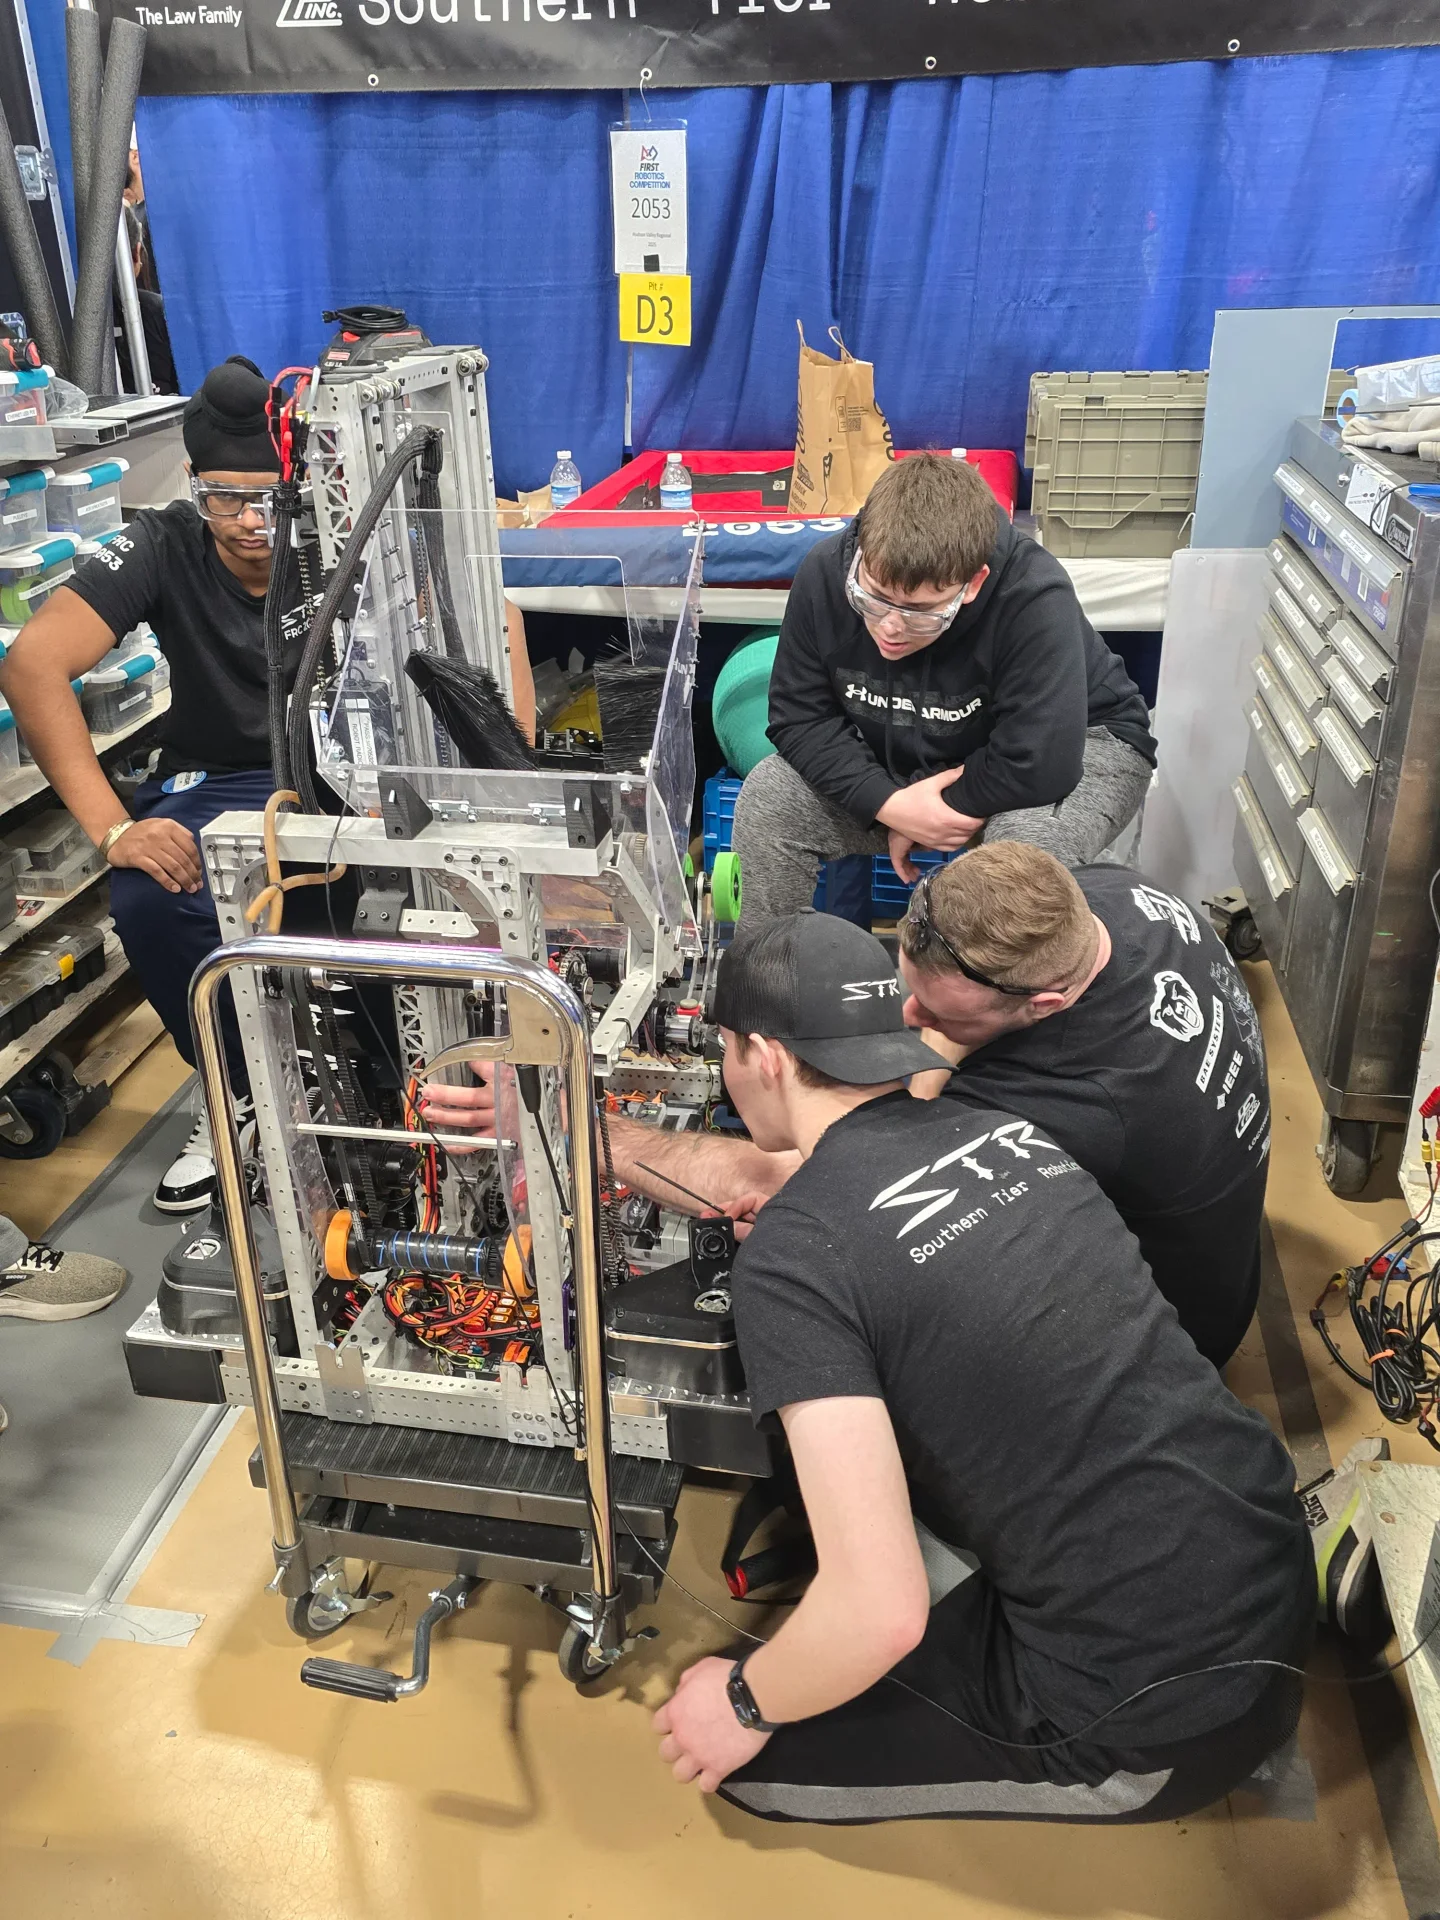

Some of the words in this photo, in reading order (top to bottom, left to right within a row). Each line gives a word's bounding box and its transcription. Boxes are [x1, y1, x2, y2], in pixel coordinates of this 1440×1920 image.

[135, 7, 163, 25] The
[165, 6, 197, 25] Law
[198, 5, 243, 28] Family
[634, 172, 665, 181] ROBOTICS
[639, 162, 660, 172] FIRST
[629, 180, 671, 189] COMPETITION
[631, 197, 671, 219] 2053
[648, 281, 657, 291] Pit
[659, 283, 664, 292] #
[637, 294, 674, 336] D3
[92, 547, 124, 571] 053
[284, 625, 303, 640] FRC
[921, 697, 982, 722] ARMOUR
[351, 722, 360, 745] ROBOT
[841, 978, 900, 1001] STR
[1200, 1060, 1211, 1085] BAE
[1209, 1003, 1223, 1058] SYSTEMS
[1222, 1050, 1244, 1094] IEEE
[868, 1120, 1062, 1240] STR
[909, 1207, 989, 1264] Southern
[991, 1180, 1029, 1206] Tier
